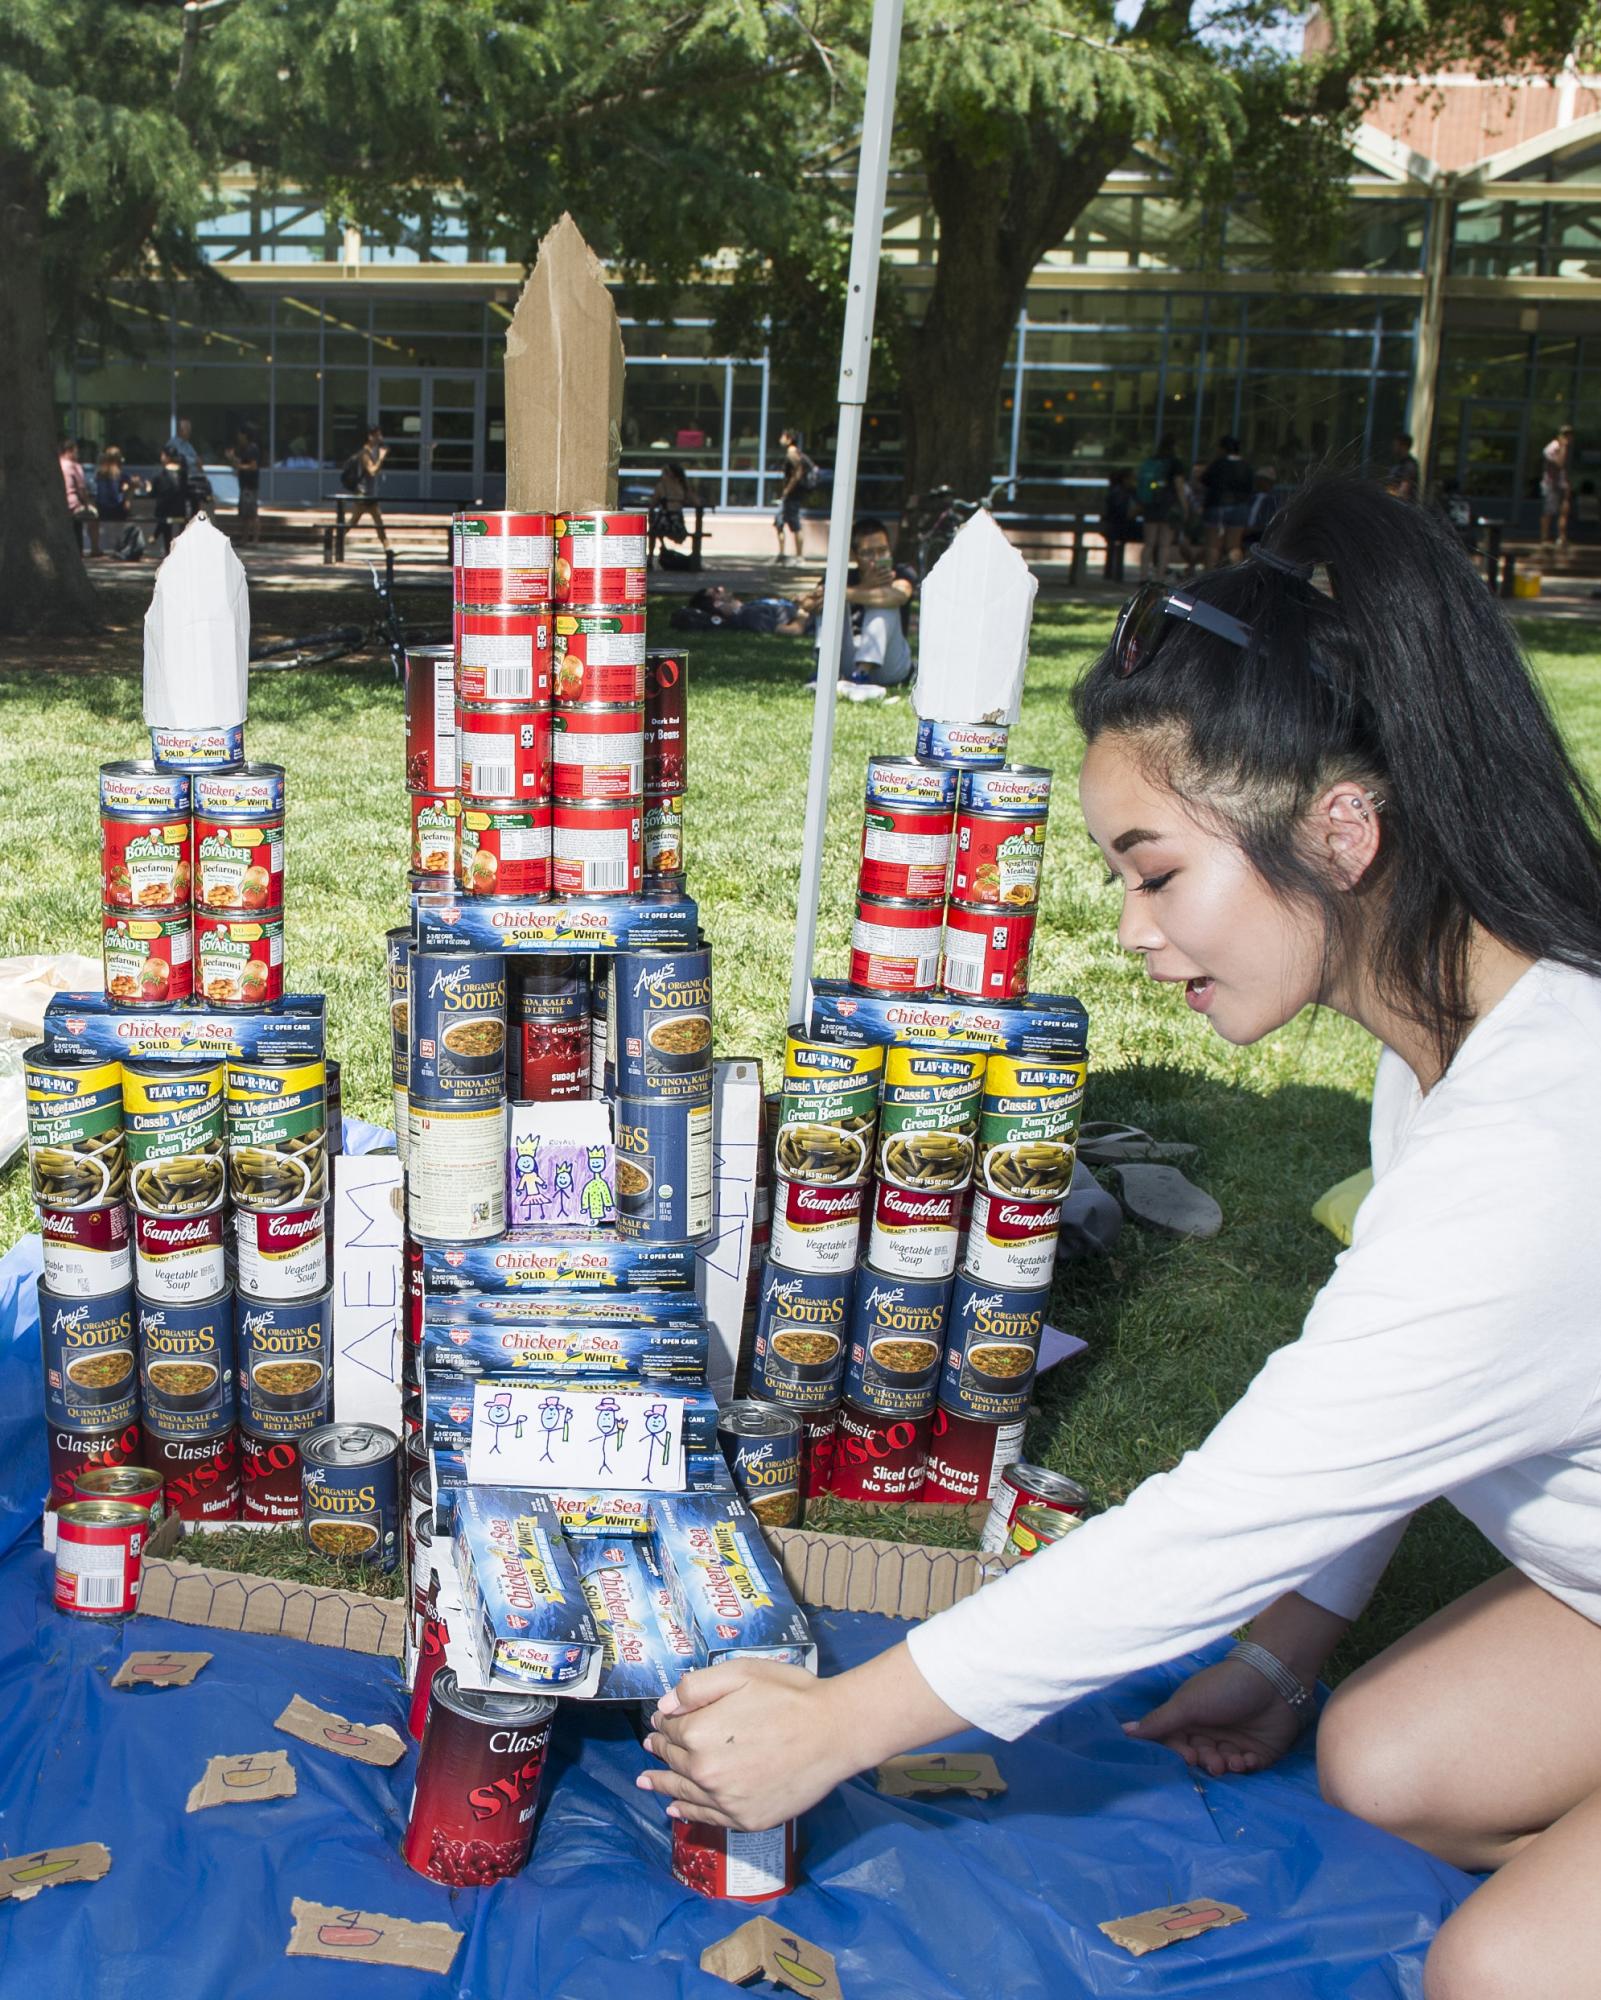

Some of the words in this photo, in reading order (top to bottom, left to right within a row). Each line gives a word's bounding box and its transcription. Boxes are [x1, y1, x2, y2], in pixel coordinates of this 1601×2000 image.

[157, 736, 191, 747] Chicken
[208, 737, 225, 746] Sea
[948, 731, 991, 744] Chicken
[873, 770, 907, 786] Chicken
[923, 777, 940, 787] Sea
[104, 781, 136, 794] Chicken
[153, 787, 170, 795] Sea
[200, 783, 235, 796] Chicken
[252, 787, 268, 795] Sea
[987, 782, 1030, 793] Chicken
[111, 796, 128, 804] SOLID
[126, 845, 180, 859] BOYARDEE
[200, 846, 251, 861] BOYARDEE
[132, 865, 173, 874] Beefaroni
[491, 911, 557, 929] Chicken
[580, 913, 608, 926] Sea
[512, 930, 543, 940] SOLID
[573, 930, 606, 940] WHITE
[105, 936, 149, 953] BOYARDEE
[200, 939, 250, 957] BOYARDEE
[429, 963, 471, 999] Amy's
[633, 962, 675, 999] Amy's
[444, 980, 505, 1011] SOUPS
[650, 976, 712, 1010] SOUPS
[886, 1008, 950, 1028] Chicken
[974, 1016, 1000, 1030] Sea
[117, 1023, 184, 1038] Chicken
[206, 1024, 233, 1037] Sea
[905, 1027, 936, 1038] SOLID
[966, 1031, 998, 1043] WHITE
[139, 1041, 169, 1049] SOLID
[200, 1042, 233, 1050] WHITE
[40, 1096, 96, 1116] Vegetables
[246, 1096, 300, 1116] Vegetables
[798, 1098, 823, 1110] Fancy
[825, 1096, 843, 1107] Cut
[915, 1106, 944, 1118] Fancy
[945, 1101, 962, 1114] Cut
[787, 1108, 816, 1122] Green
[818, 1106, 853, 1121] Beans
[902, 1117, 936, 1131] Green
[938, 1111, 970, 1128] Beans
[1021, 1118, 1050, 1129] Fancy
[1050, 1113, 1067, 1126] Cut
[1006, 1128, 1042, 1142] Green
[1044, 1120, 1074, 1138] Beans
[802, 1225, 824, 1233] READY
[886, 1227, 907, 1235] READY
[805, 1239, 847, 1250] Vegetable
[889, 1241, 933, 1256] Vegetable
[496, 1252, 556, 1270] Chicken
[581, 1256, 608, 1268] Sea
[817, 1250, 840, 1262] Soup
[899, 1254, 923, 1266] Soup
[1007, 1255, 1049, 1265] Vegetable
[155, 1268, 198, 1281] Vegetable
[514, 1270, 546, 1280] SOLID
[574, 1270, 608, 1280] WHITE
[1018, 1265, 1040, 1277] Soup
[167, 1280, 191, 1291] Soup
[766, 1278, 803, 1301] Amy's
[864, 1286, 904, 1310] Amy's
[962, 1292, 1004, 1317] Amy's
[476, 1301, 559, 1312] Chicken
[603, 1304, 641, 1312] Sea
[777, 1295, 844, 1322] SOUPS
[52, 1305, 89, 1334] Amy's
[242, 1310, 275, 1334] Amy's
[876, 1305, 944, 1330] SOUPS
[974, 1309, 1041, 1336] SOUPS
[66, 1312, 131, 1347] SOUPS
[253, 1323, 321, 1352] SOUPS
[146, 1325, 215, 1353] SOUPS
[502, 1334, 567, 1350] Chicken
[590, 1337, 618, 1350] Sea
[522, 1352, 554, 1362] SOLID
[583, 1353, 618, 1364] WHITE
[765, 1378, 804, 1392] QUINOA,
[806, 1384, 827, 1394] KALE
[776, 1389, 793, 1399] RED
[795, 1391, 825, 1401] LENTIL
[148, 1408, 184, 1420] QUINOA,
[186, 1411, 209, 1421] KALE
[211, 1411, 219, 1419] &
[158, 1420, 175, 1430] RED
[176, 1420, 210, 1431] LENTIL
[56, 1433, 115, 1453] Classic
[164, 1442, 225, 1461] Classic
[735, 1443, 773, 1468] Amy's
[872, 1466, 905, 1481] Sliced
[939, 1462, 979, 1483] Carrots
[862, 1479, 881, 1492] No
[884, 1482, 906, 1493] Salt
[938, 1478, 978, 1496] Added
[202, 1498, 229, 1514] Kidney
[265, 1494, 282, 1502] Dark
[284, 1494, 298, 1502] Red
[308, 1484, 376, 1512] SOUPS
[604, 1516, 641, 1527] WHITE
[491, 1520, 514, 1540] Sea
[517, 1522, 533, 1545] WHITE
[690, 1528, 712, 1549] Sea
[715, 1528, 735, 1552] WHITE
[502, 1556, 534, 1609] Chicken
[531, 1569, 551, 1594] SOLID
[735, 1574, 757, 1599] SOLID
[706, 1566, 743, 1618] Chicken
[527, 1649, 548, 1660] Sea
[520, 1661, 549, 1674] WHITE
[467, 1754, 541, 1821] SYS
